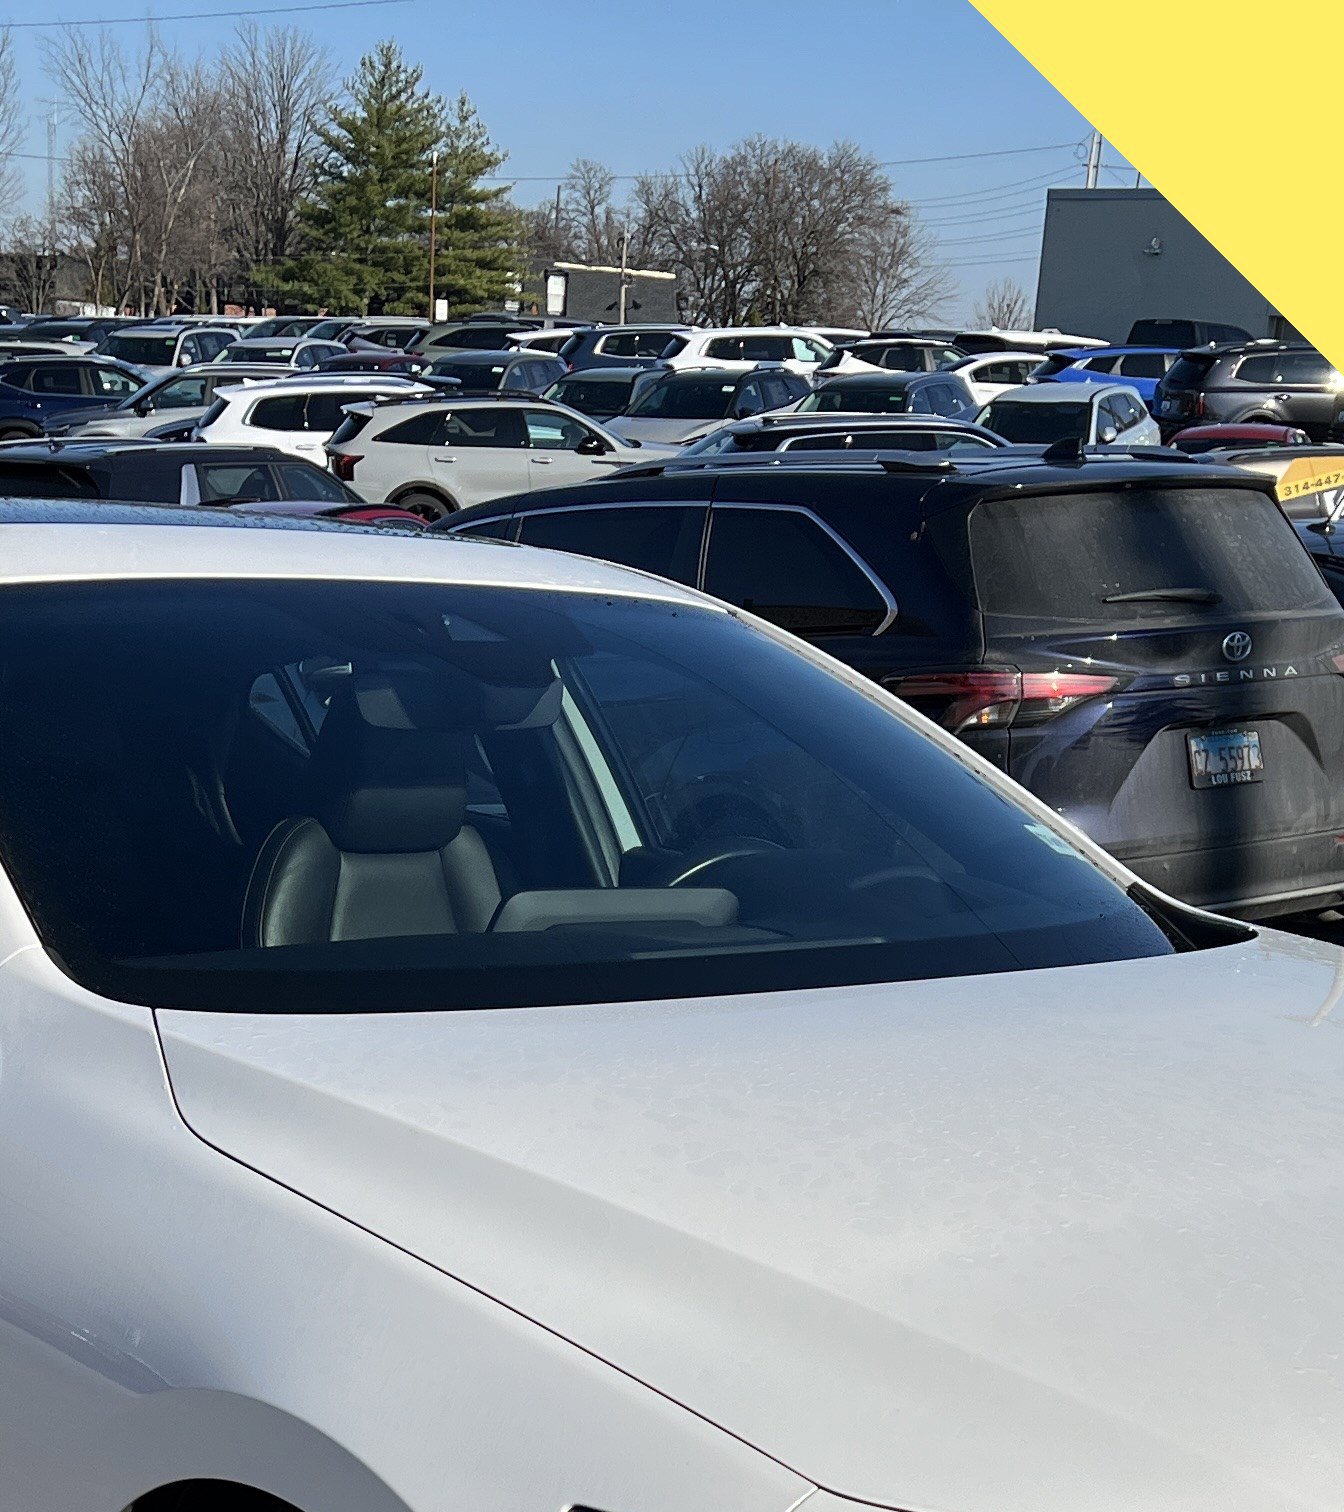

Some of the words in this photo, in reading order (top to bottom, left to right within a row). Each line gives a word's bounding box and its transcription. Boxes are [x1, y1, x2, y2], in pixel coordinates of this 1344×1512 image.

[1173, 665, 1298, 688] SIENNA
[1210, 773, 1229, 785] LOU
[1230, 770, 1252, 783] FUSZ
